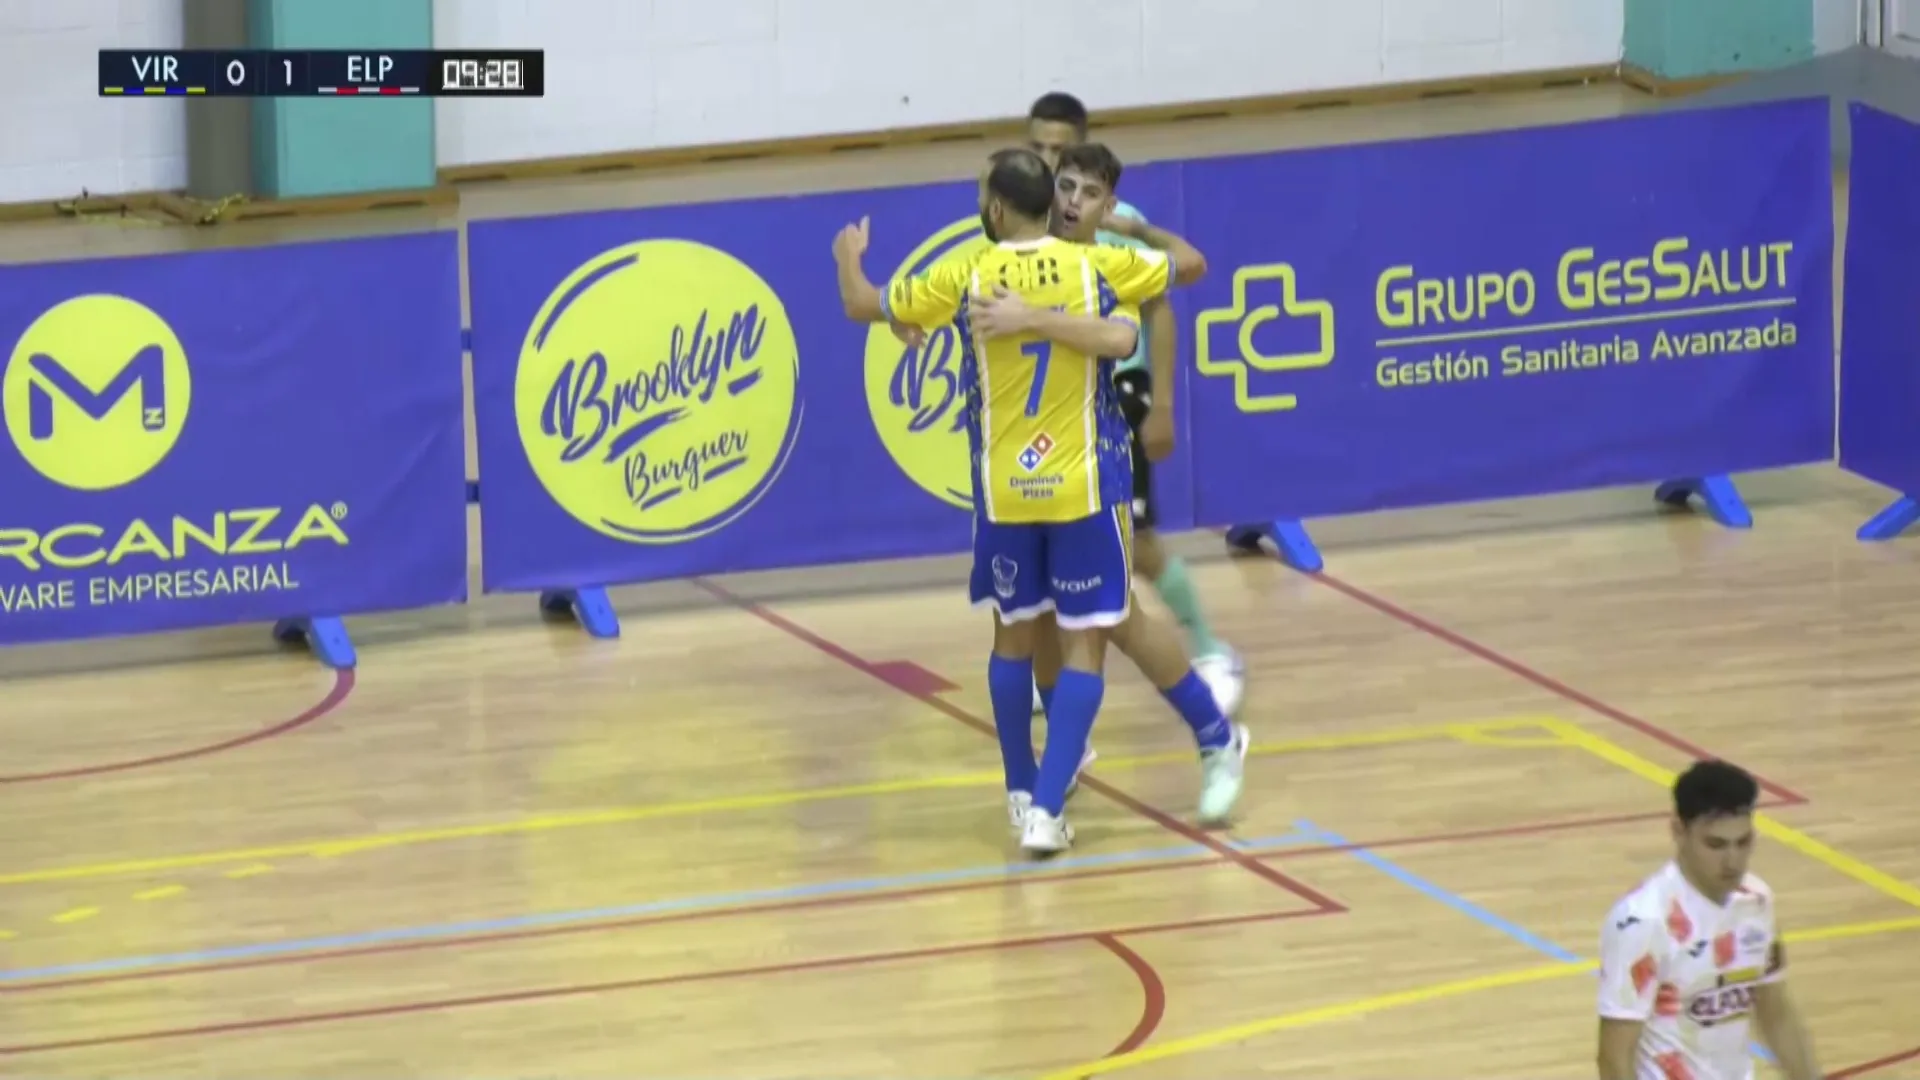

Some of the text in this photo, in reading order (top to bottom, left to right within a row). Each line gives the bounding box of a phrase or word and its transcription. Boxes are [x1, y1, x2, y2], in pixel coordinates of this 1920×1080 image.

[540, 302, 767, 463] Brooklyn
[1020, 341, 1052, 417] 7
[1376, 318, 1798, 387] Gestión Sanitaria Avanzada
[624, 429, 749, 506] Burguer
[89, 561, 299, 606] EMPRESARIAL
